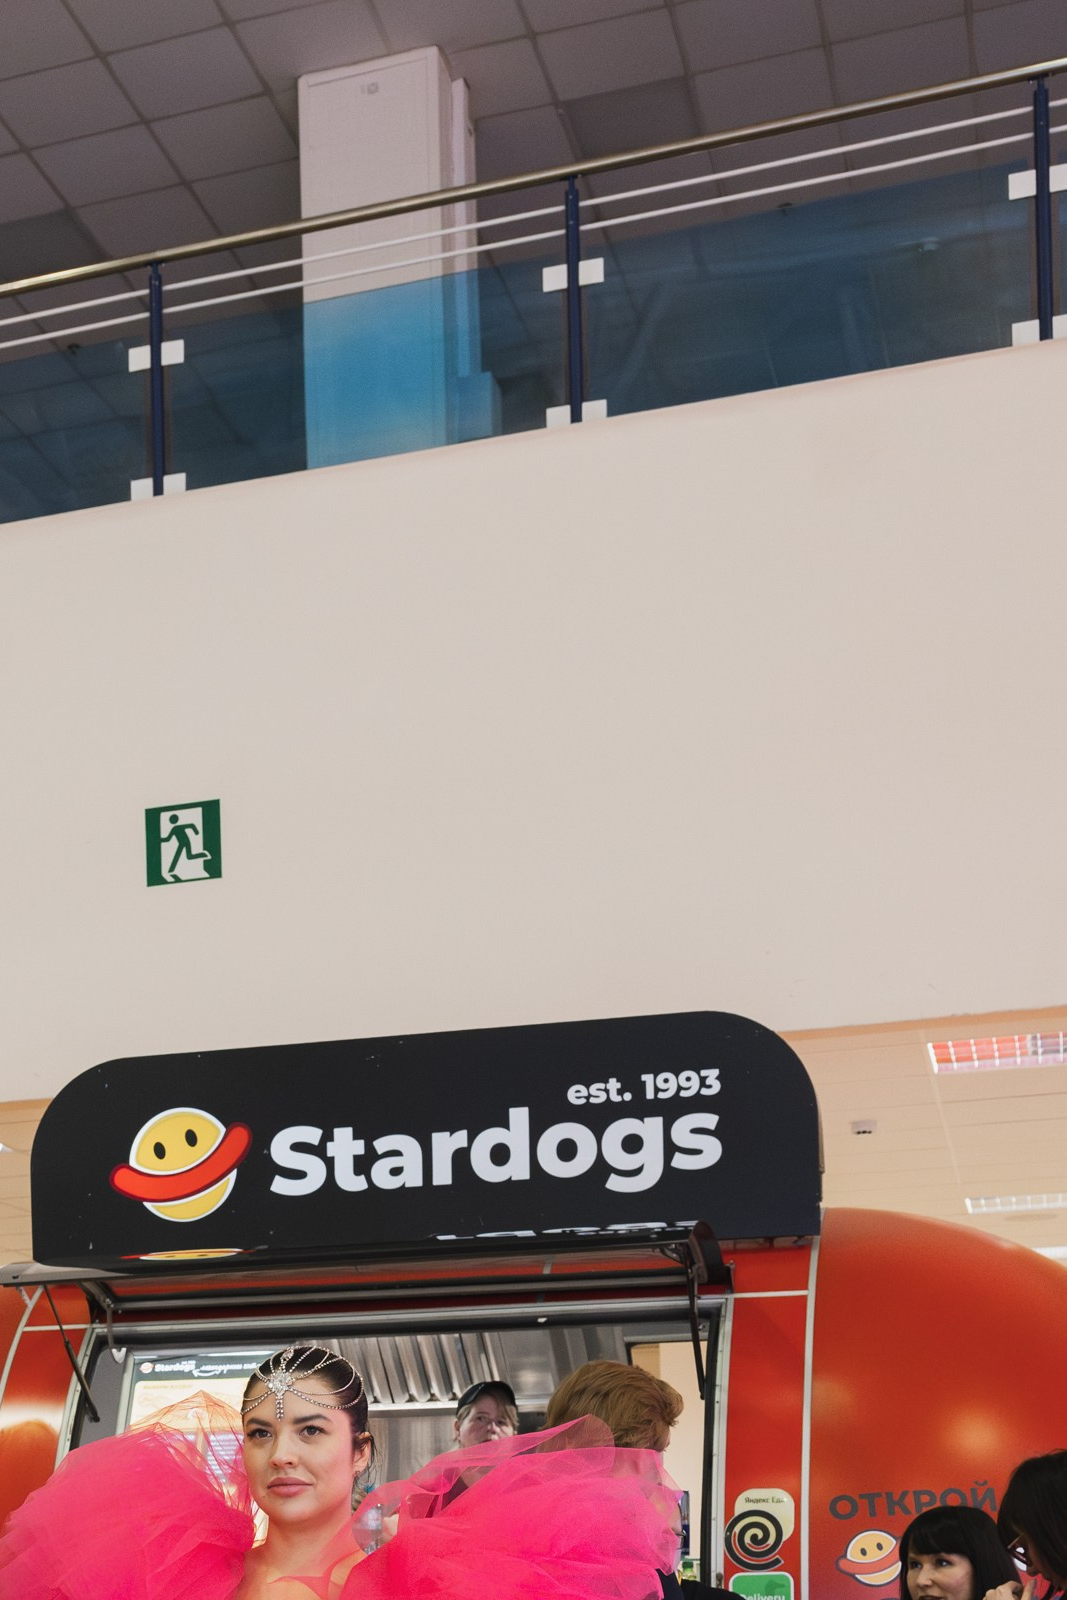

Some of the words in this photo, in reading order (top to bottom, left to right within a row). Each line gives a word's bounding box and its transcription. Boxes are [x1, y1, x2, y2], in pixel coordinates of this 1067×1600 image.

[567, 1077, 632, 1105] est.
[641, 1068, 722, 1100] 1993
[269, 1106, 723, 1196] Stardogs
